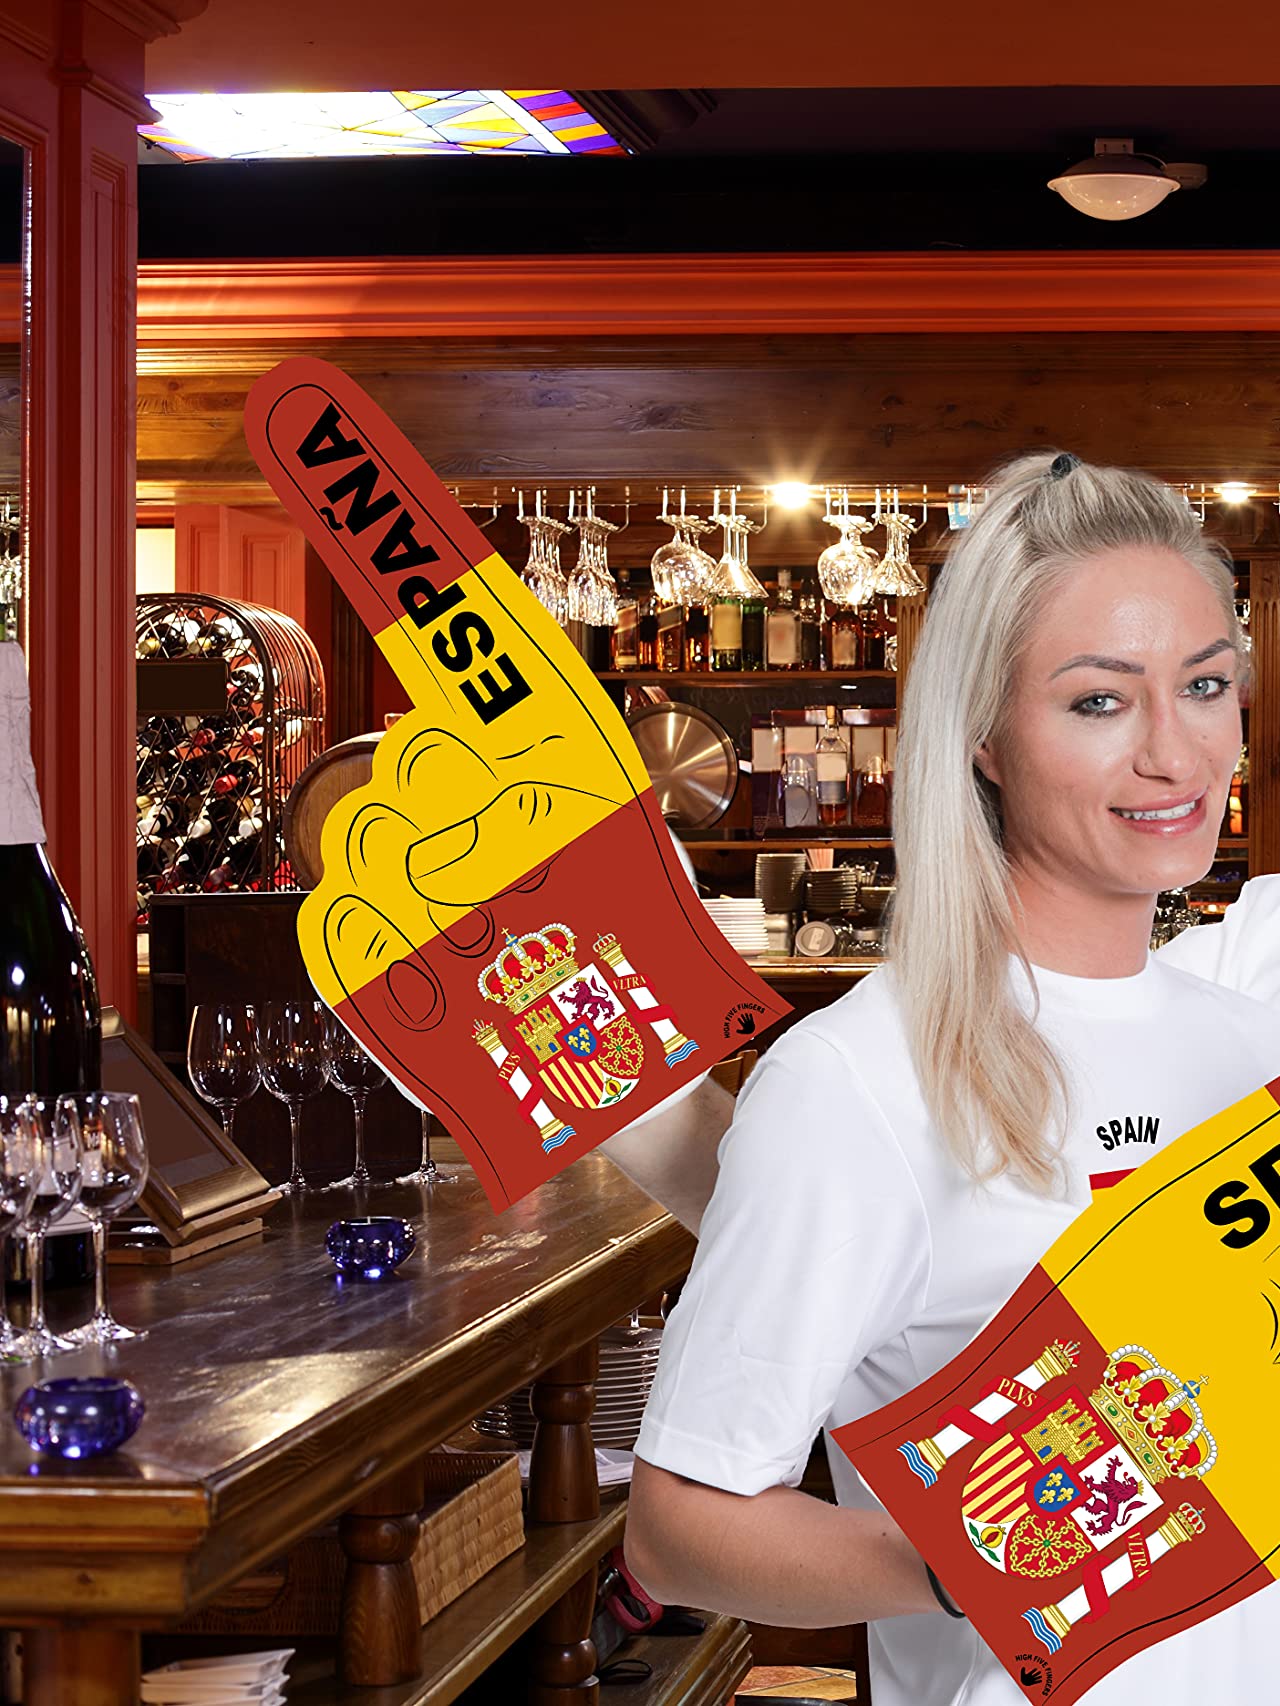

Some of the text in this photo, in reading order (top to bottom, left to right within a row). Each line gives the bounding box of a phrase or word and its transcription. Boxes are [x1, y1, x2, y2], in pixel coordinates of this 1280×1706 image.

[295, 402, 533, 726] ESPAÑA
[612, 975, 647, 990] VLTRA
[725, 1006, 738, 1022] FIVE
[737, 1003, 766, 1014] FINGERS
[498, 1051, 521, 1081] PLVS
[1096, 1115, 1161, 1152] SPAIN
[997, 1378, 1037, 1407] PLVS
[1128, 1531, 1150, 1578] VLTRA
[1015, 1653, 1033, 1662] HIGH
[1033, 1655, 1049, 1669] FIVE
